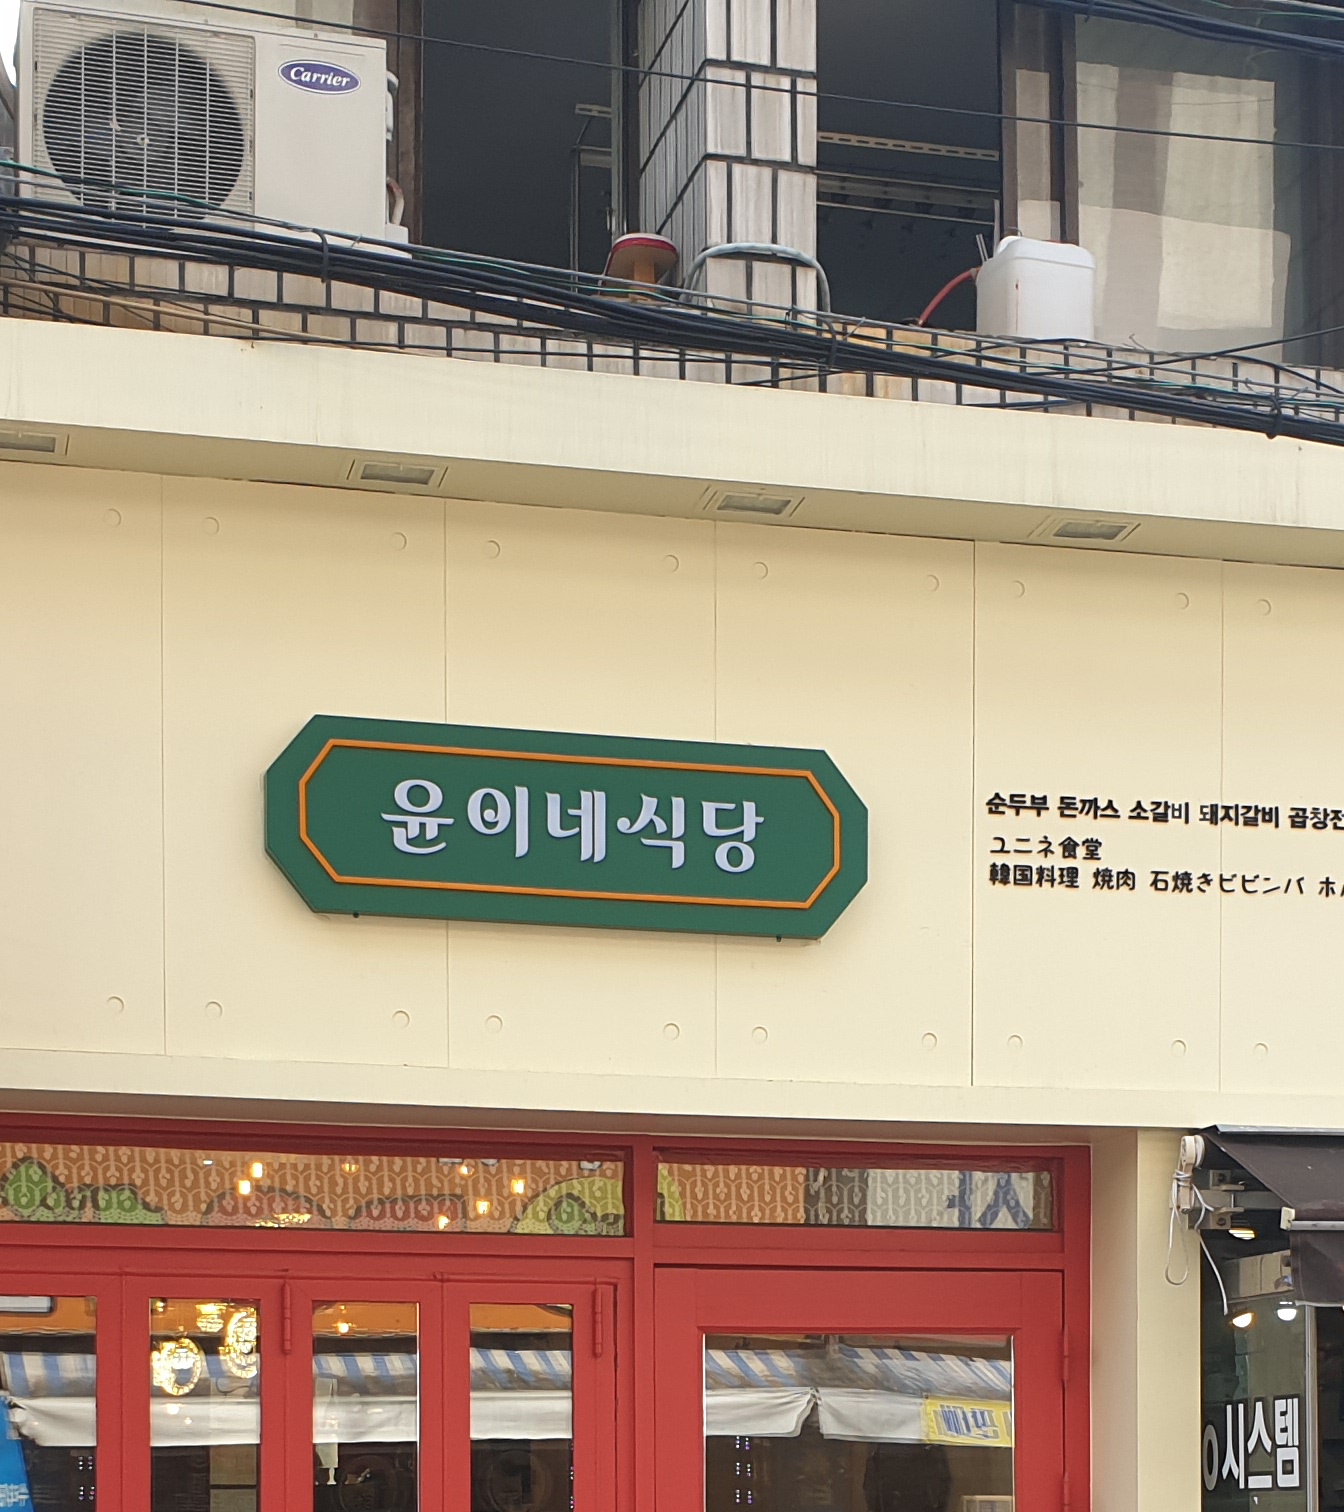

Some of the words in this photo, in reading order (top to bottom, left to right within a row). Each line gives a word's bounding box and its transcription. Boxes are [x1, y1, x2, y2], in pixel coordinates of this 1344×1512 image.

[289, 66, 352, 89] Carrier
[986, 792, 1050, 817] 순두부
[1057, 796, 1121, 820] 돈까스
[1128, 800, 1190, 824] 소갈비
[1199, 802, 1281, 828] 돼지갈비
[381, 778, 764, 873] 윤이네식당
[989, 835, 1103, 861] ユニネ食堂
[988, 862, 1080, 889] 韓国料理
[1092, 867, 1137, 891] 焼肉
